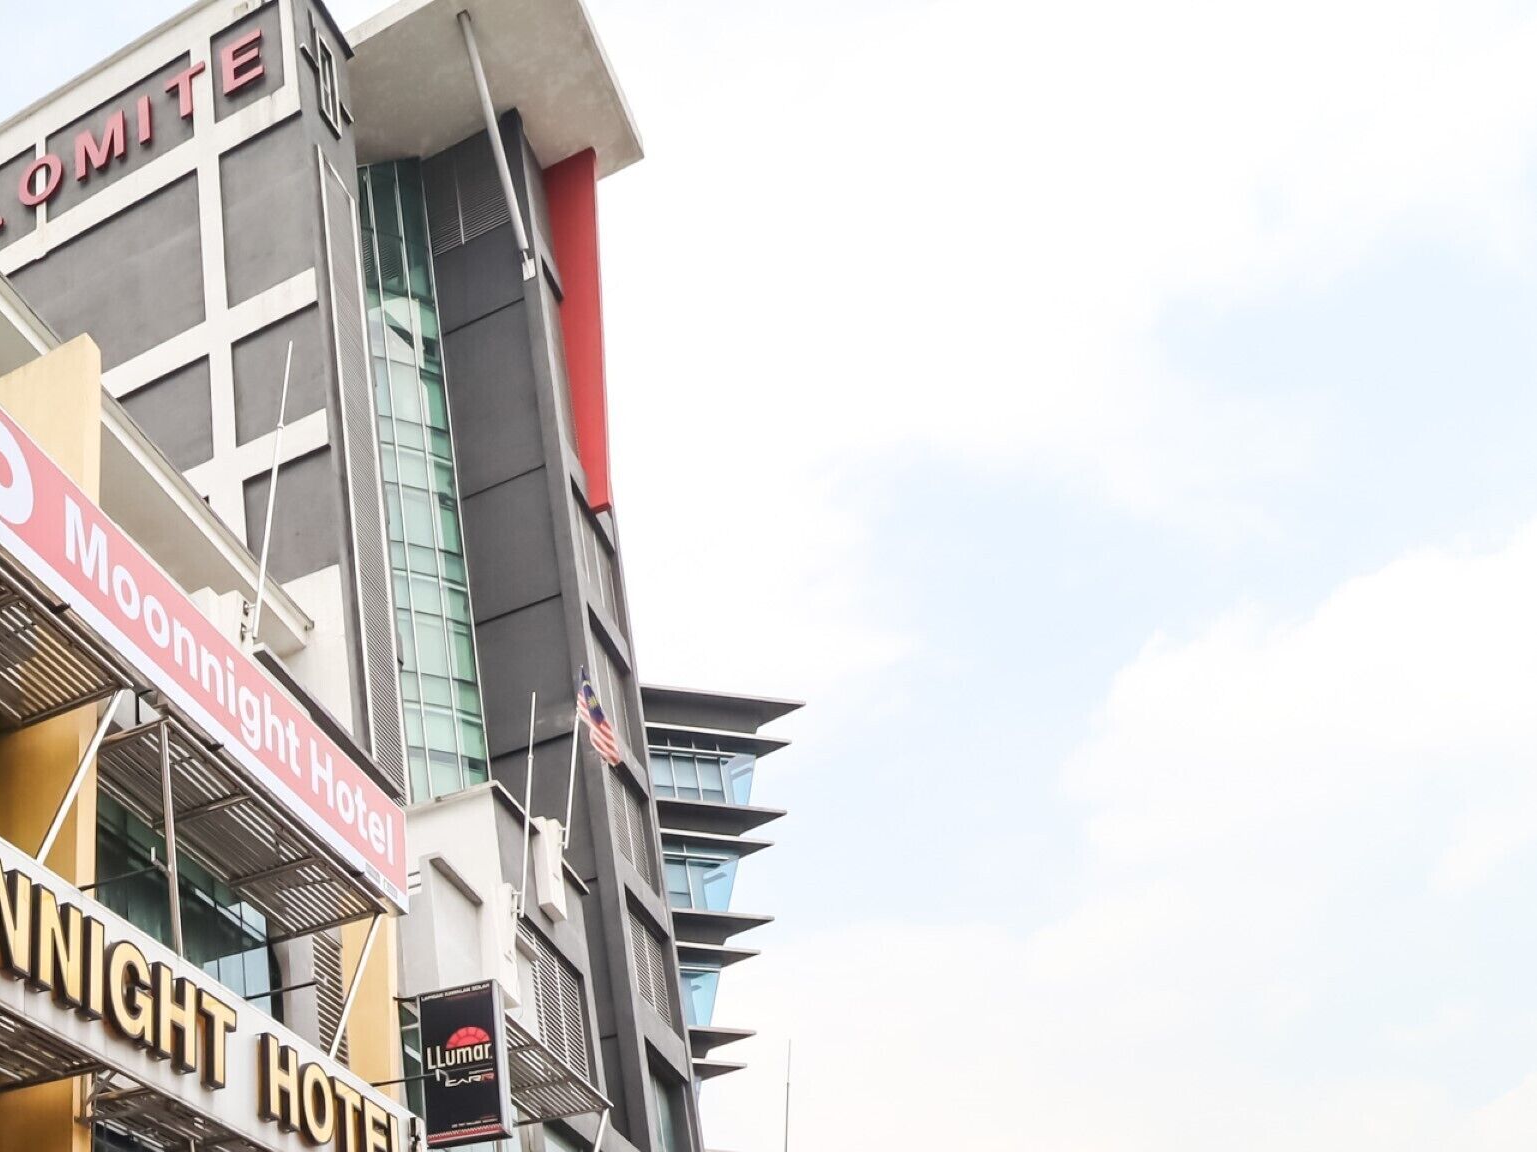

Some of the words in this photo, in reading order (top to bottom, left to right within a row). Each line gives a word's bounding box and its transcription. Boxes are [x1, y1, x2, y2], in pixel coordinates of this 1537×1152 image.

[65, 494, 302, 776] Moonnight
[309, 738, 394, 865] Hotel
[427, 1043, 492, 1069] LLumar
